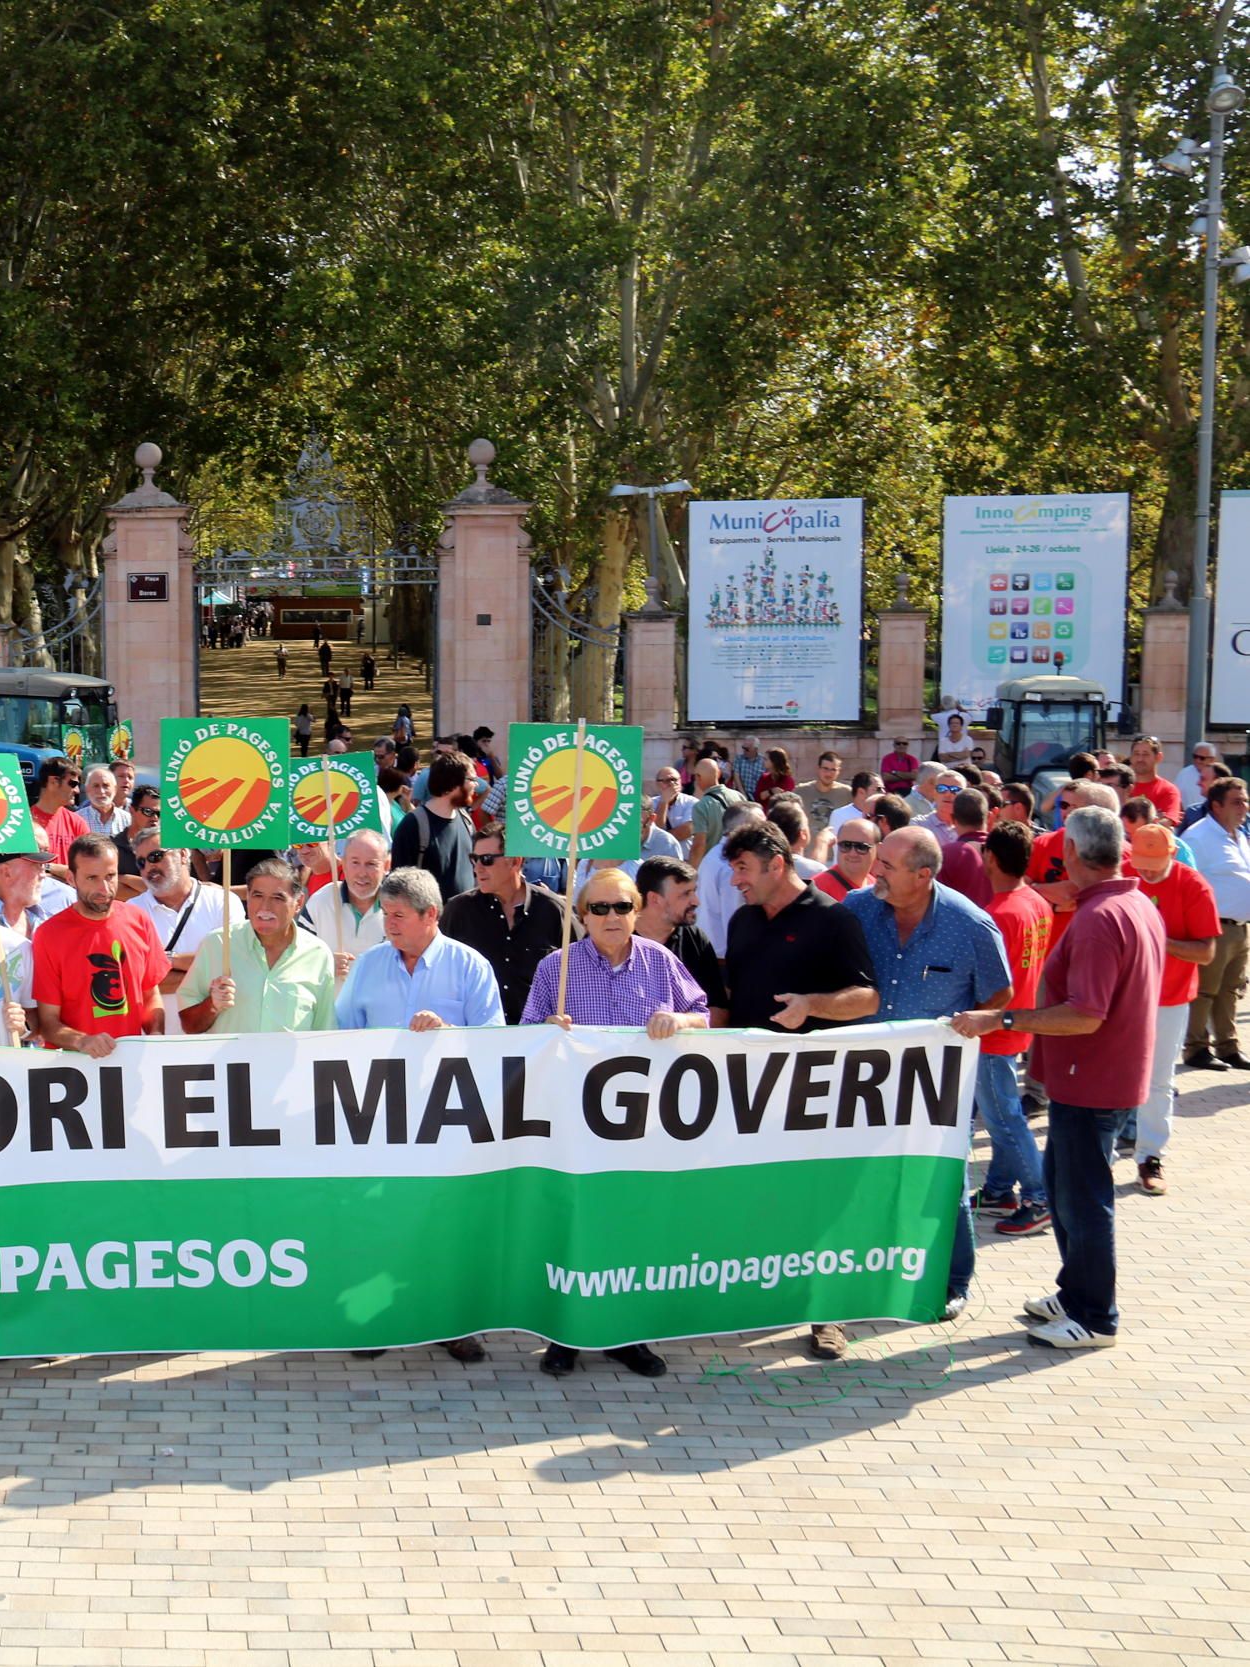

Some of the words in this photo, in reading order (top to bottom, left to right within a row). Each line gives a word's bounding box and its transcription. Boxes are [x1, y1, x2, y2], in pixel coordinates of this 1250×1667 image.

[710, 537, 761, 545] Equipaments
[1049, 544, 1081, 553] octubre
[165, 738, 192, 782] UNIÓ
[194, 724, 220, 742] DE
[227, 723, 284, 788] PAGESOS
[298, 762, 319, 775] DE
[513, 746, 543, 793] UNIÓ
[542, 733, 569, 752] DE
[167, 795, 188, 820] DE
[184, 802, 282, 844] CATALUNYA
[514, 798, 536, 826] DE
[162, 1062, 281, 1149] EL
[313, 1056, 551, 1146] MAL
[582, 1045, 962, 1142] GOVERN
[546, 1246, 926, 1297] www.uniopagesos.org
